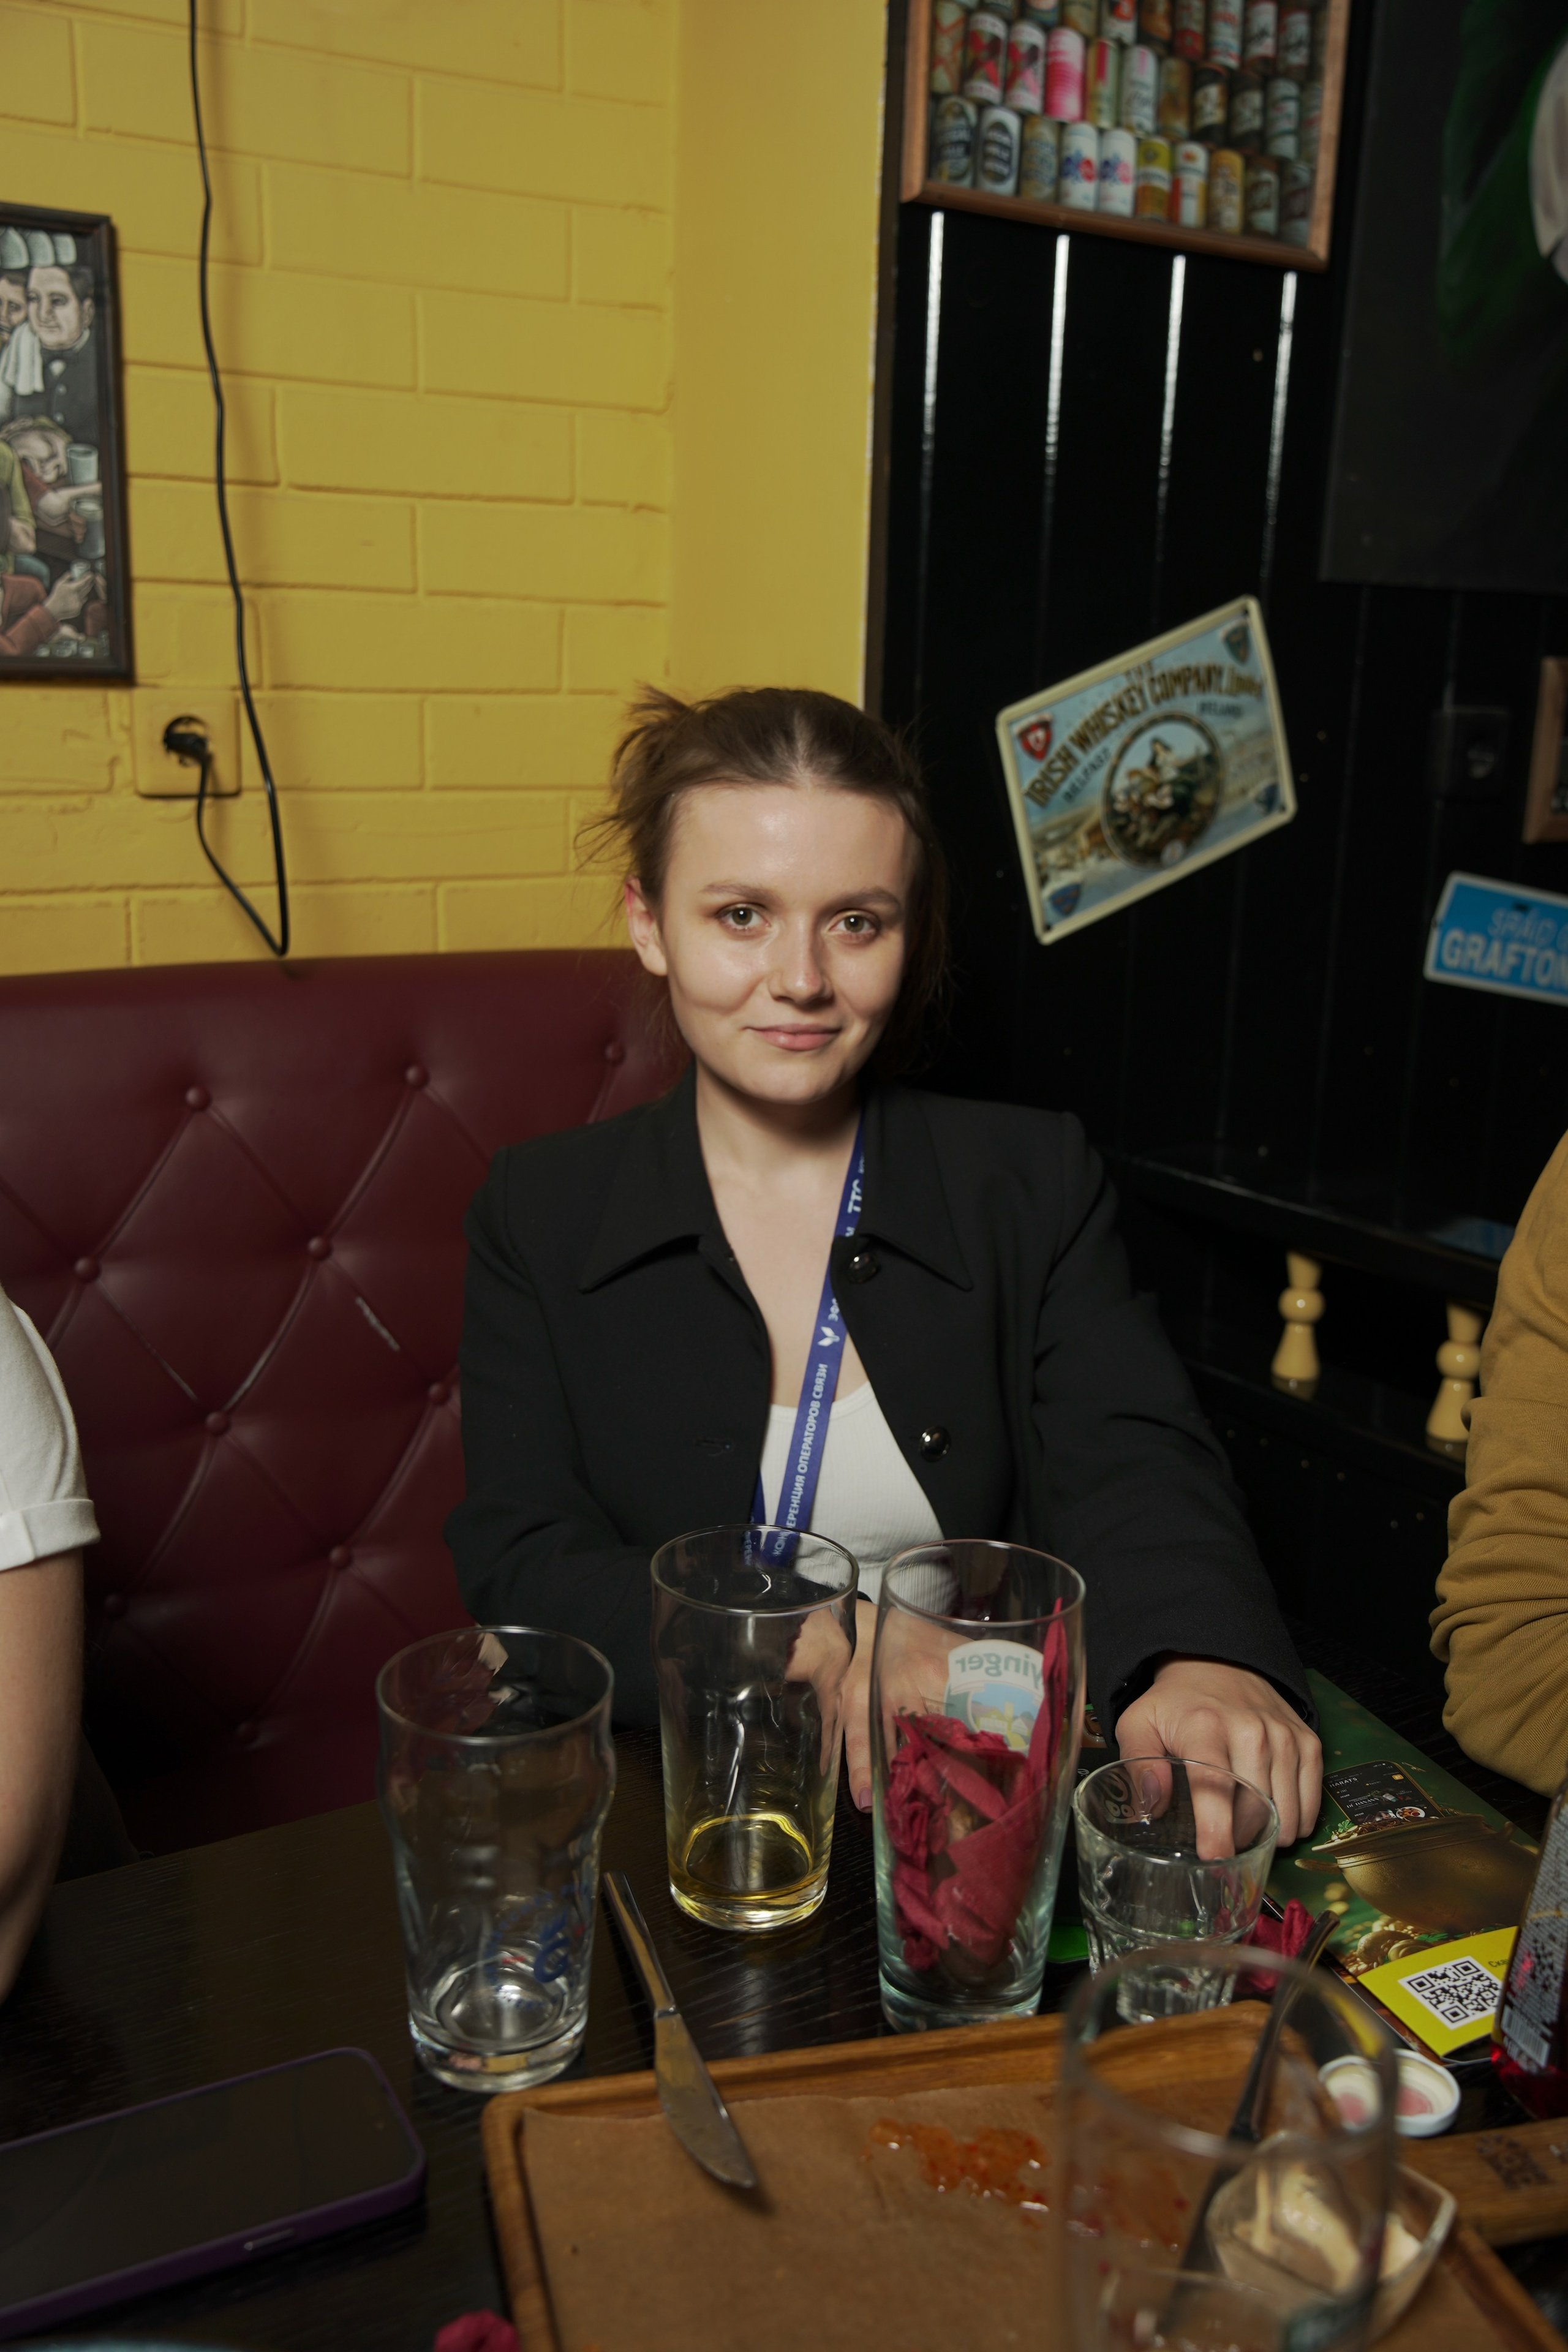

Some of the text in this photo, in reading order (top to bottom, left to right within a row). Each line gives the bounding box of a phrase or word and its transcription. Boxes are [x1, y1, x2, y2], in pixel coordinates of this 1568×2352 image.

[1023, 749, 1080, 807] IRISH
[1071, 683, 1148, 752] WHISKEY
[772, 1363, 828, 1556] КОНЕРЕНЦИЯ ОПЕРАТОРОВ СВЯЗИ
